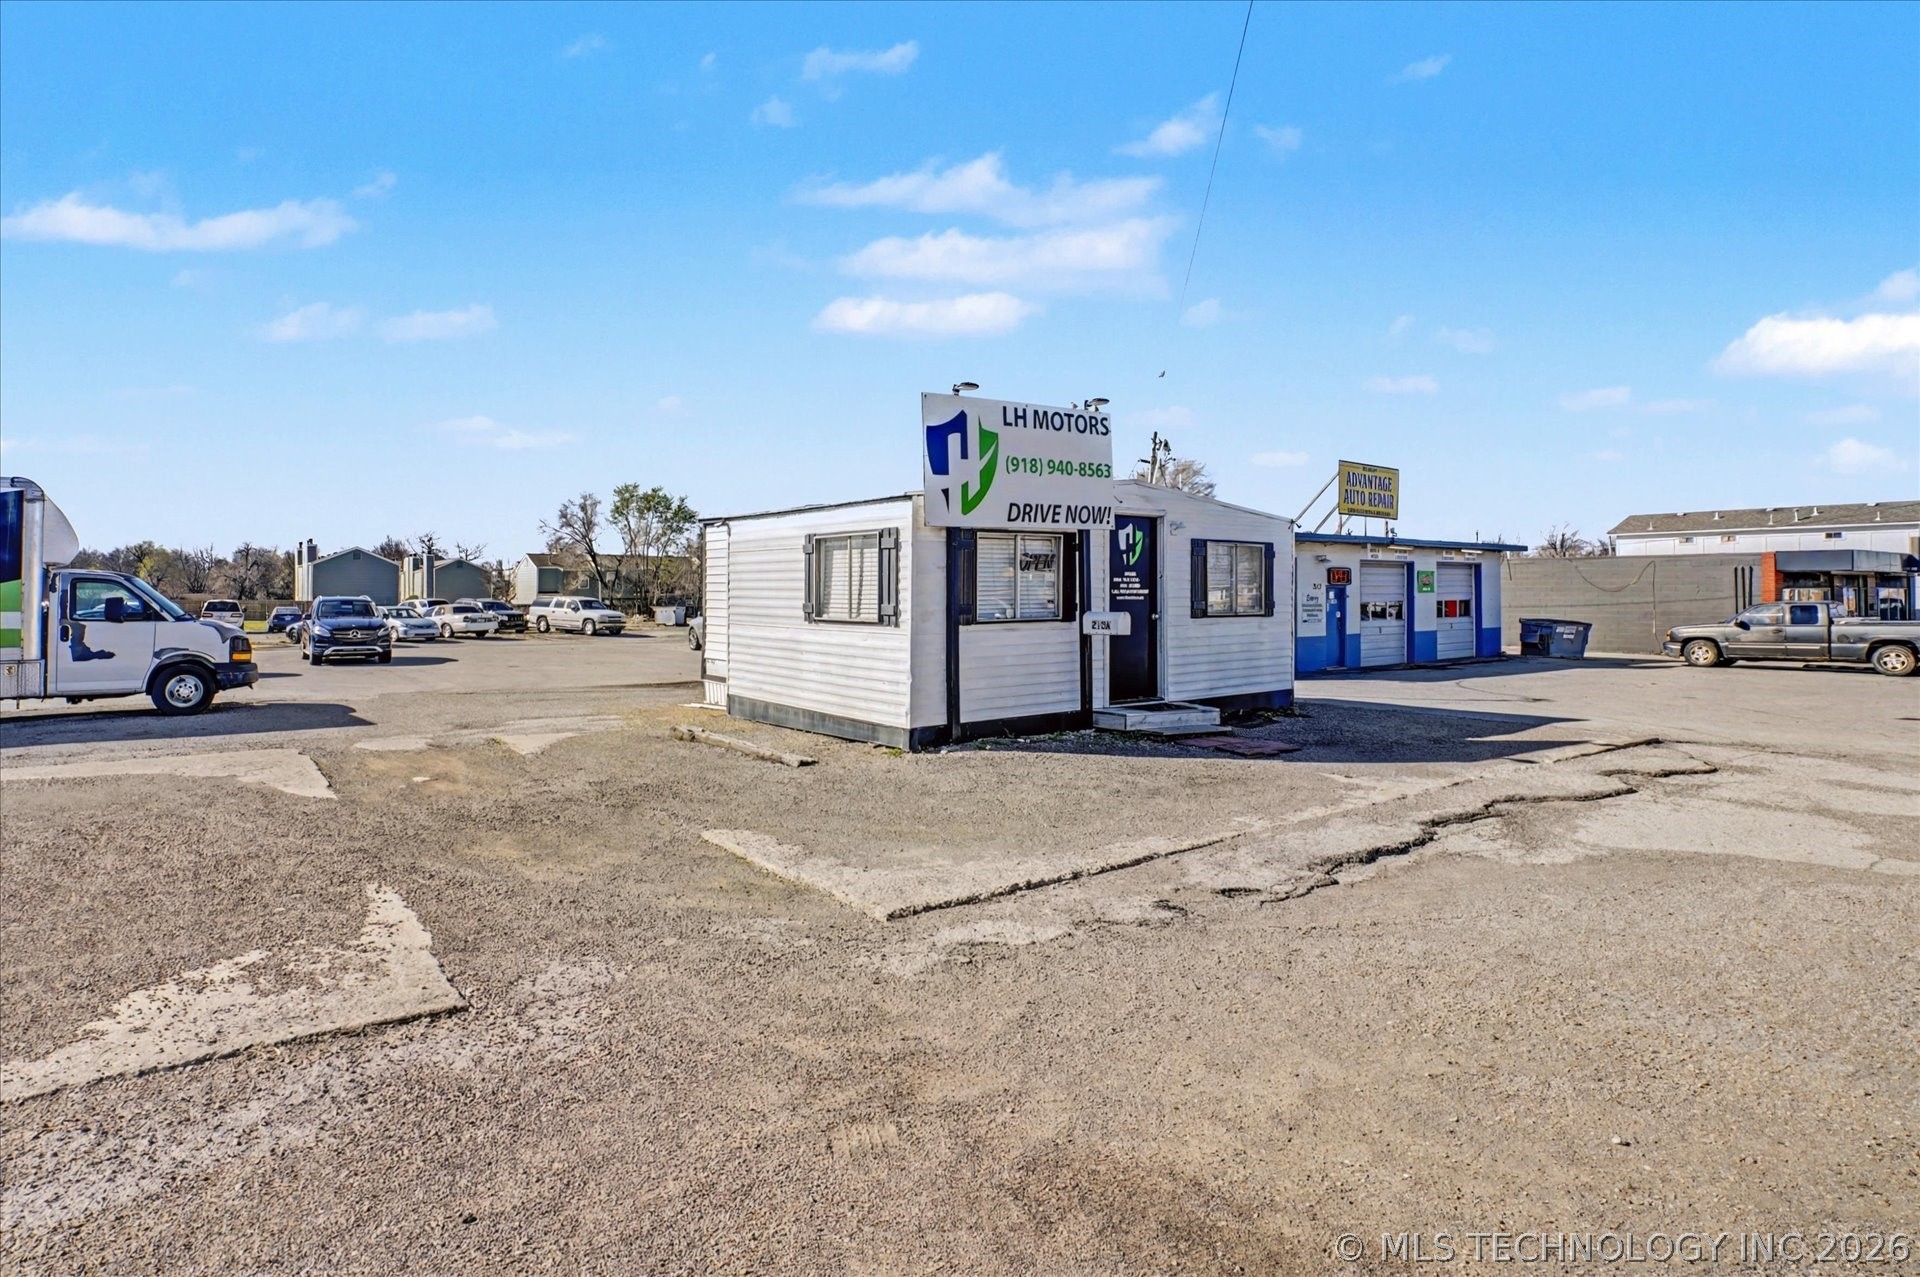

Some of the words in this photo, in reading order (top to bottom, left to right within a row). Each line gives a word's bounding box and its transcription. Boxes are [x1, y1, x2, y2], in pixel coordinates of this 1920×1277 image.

[1003, 406, 1027, 428] LH
[1033, 409, 1109, 436] MOTORS
[1006, 455, 1043, 476] (918)
[1047, 459, 1111, 478] 940-8563
[1346, 471, 1393, 492] ADVANTAGE
[1343, 488, 1366, 506] AUTO
[1368, 491, 1395, 510] REPAIR
[1007, 502, 1062, 524] DRIVE
[1065, 505, 1112, 525] NOW!
[1019, 552, 1056, 572] OPEN
